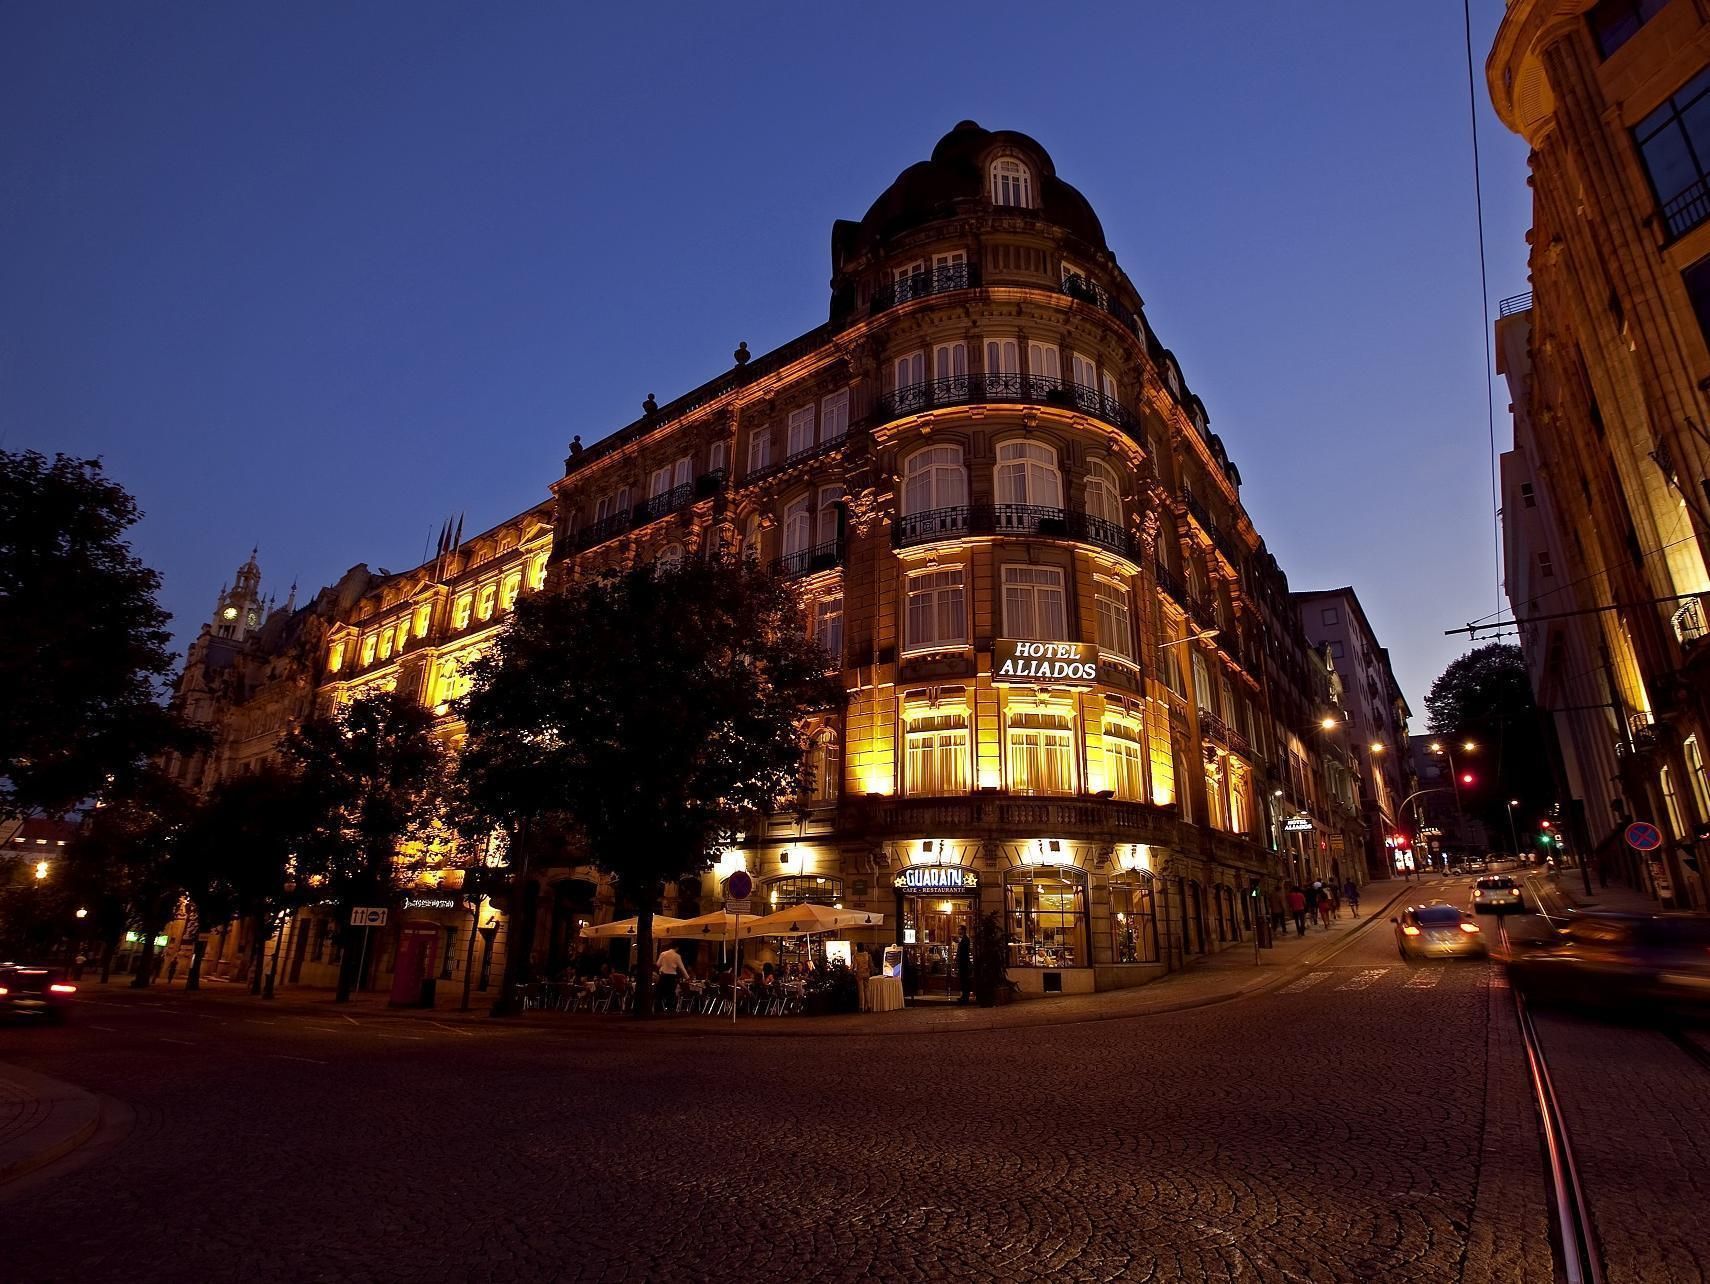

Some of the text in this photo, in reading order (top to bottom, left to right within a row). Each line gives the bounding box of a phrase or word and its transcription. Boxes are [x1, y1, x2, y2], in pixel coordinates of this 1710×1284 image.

[1014, 642, 1080, 659] HOTEL
[999, 659, 1096, 679] ALIADOS
[905, 868, 962, 887] GUARANY
